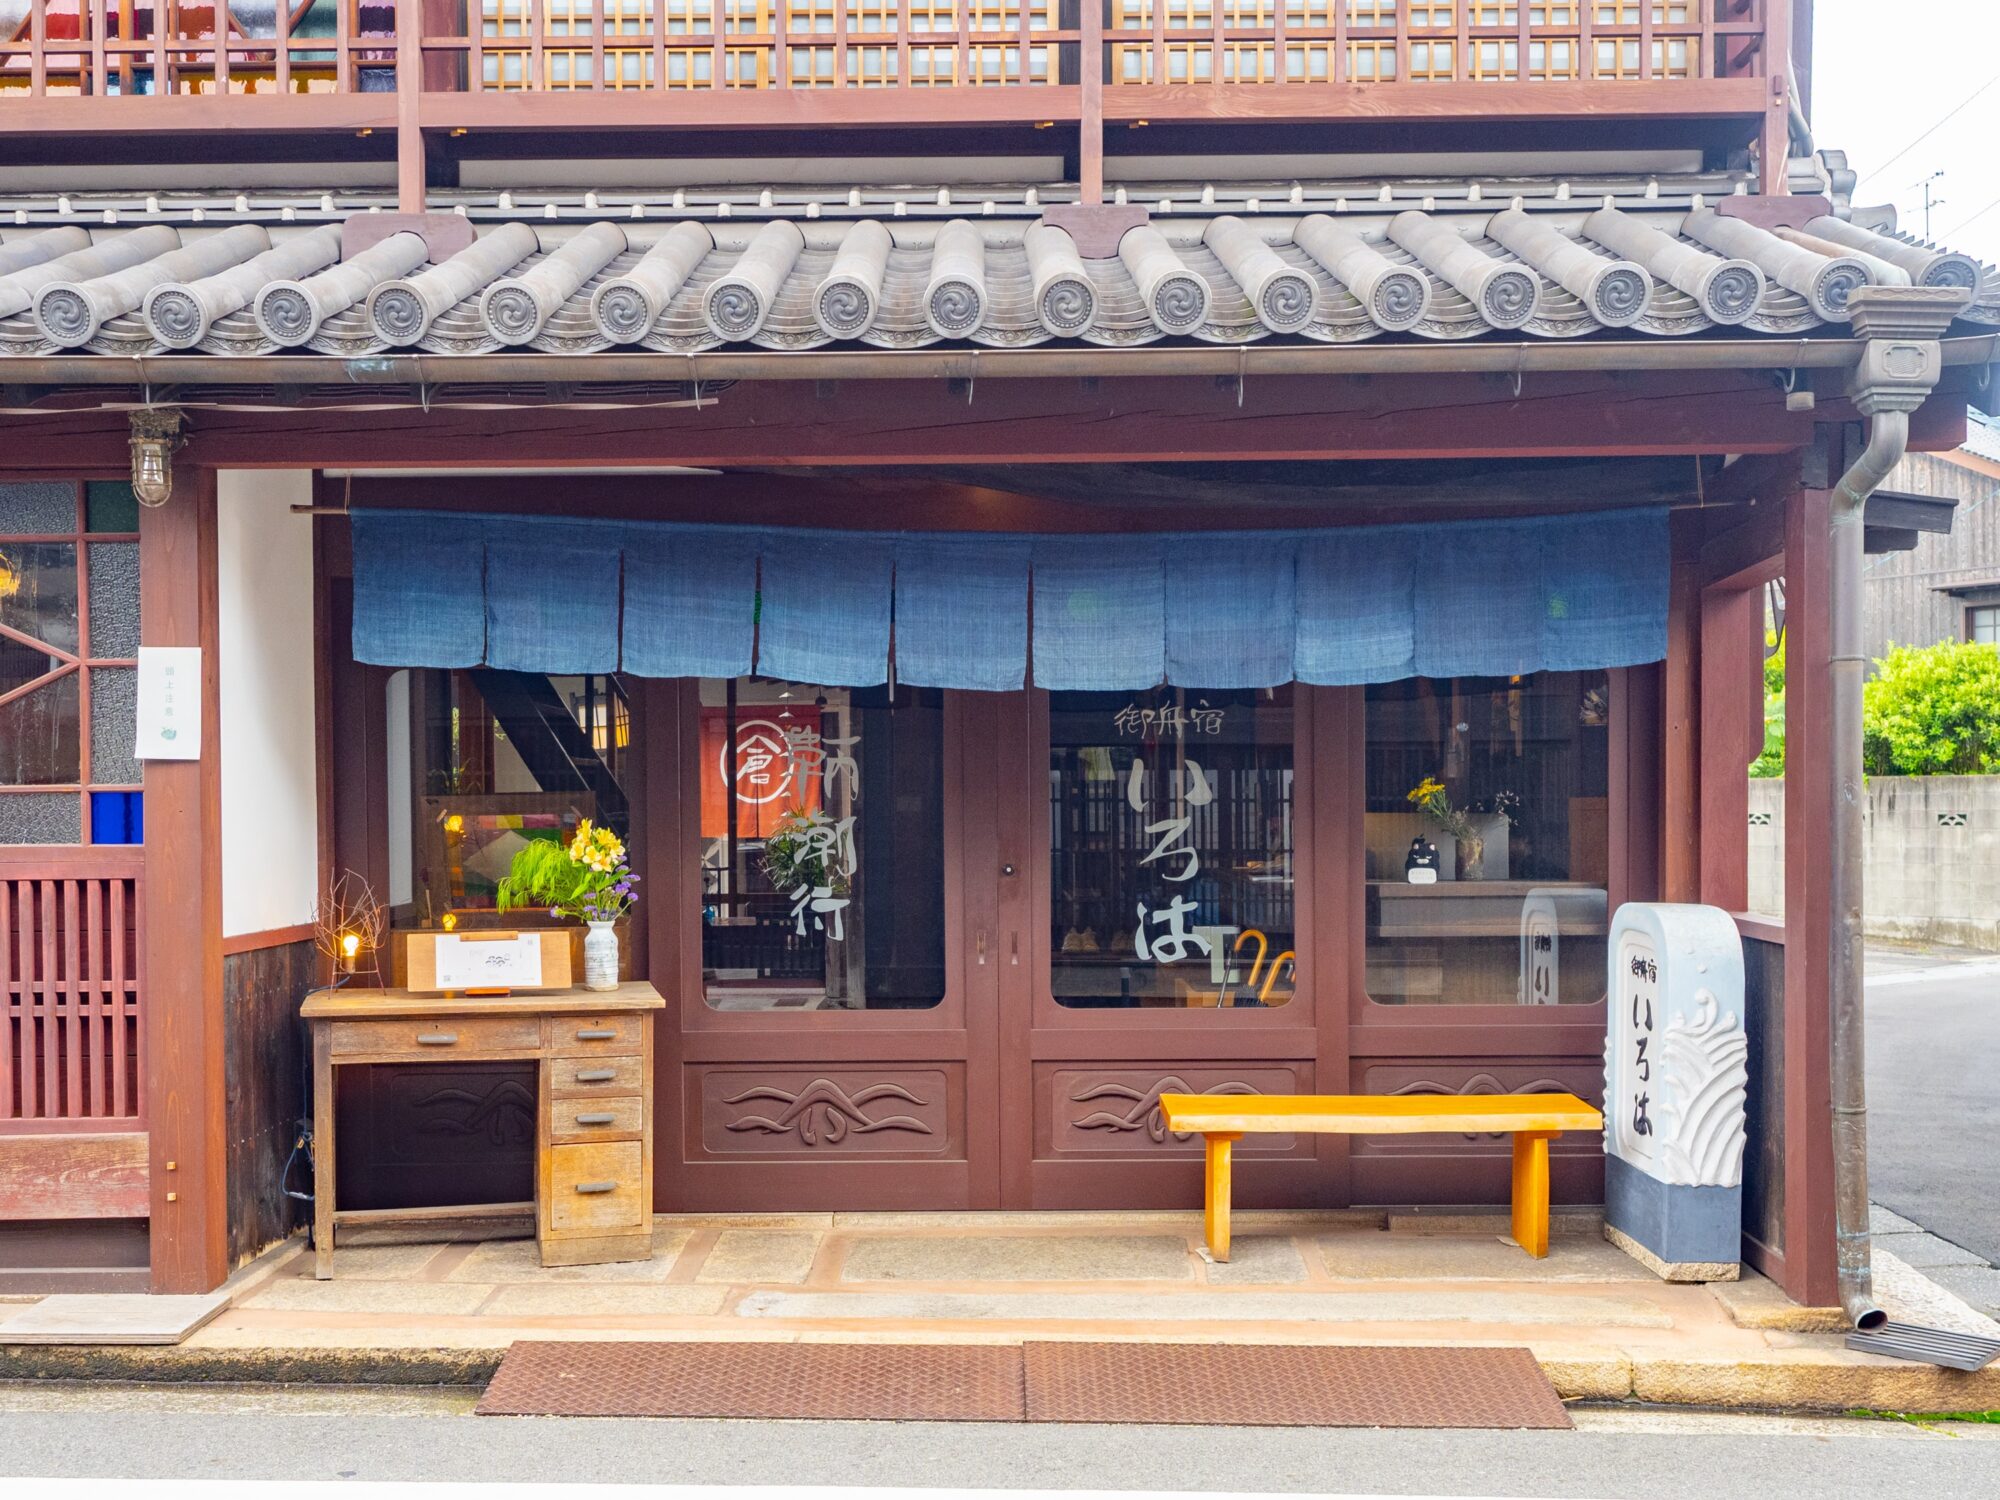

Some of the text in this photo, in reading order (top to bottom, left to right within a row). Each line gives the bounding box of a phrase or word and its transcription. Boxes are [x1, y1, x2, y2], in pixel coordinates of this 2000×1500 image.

[735, 734, 782, 785] 倉
[1114, 699, 1225, 740] 御舟宿
[1128, 757, 1213, 964] いろは
[1632, 993, 1654, 1137] いろは
